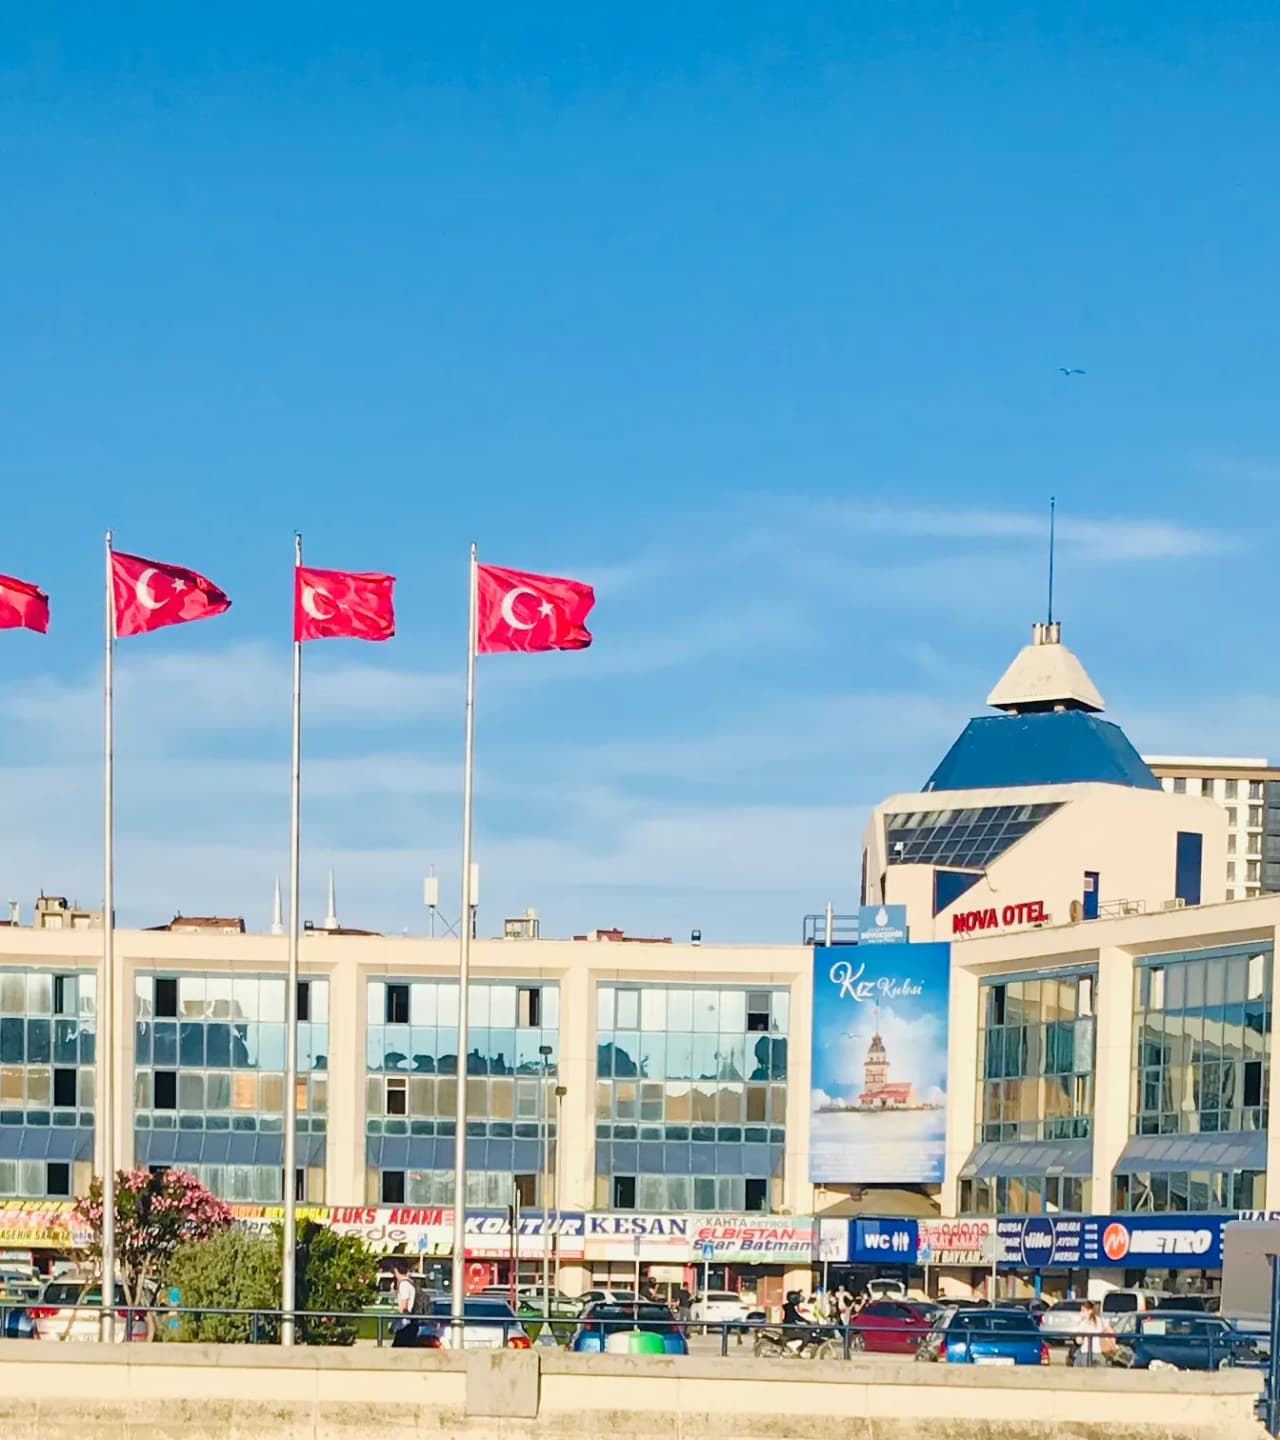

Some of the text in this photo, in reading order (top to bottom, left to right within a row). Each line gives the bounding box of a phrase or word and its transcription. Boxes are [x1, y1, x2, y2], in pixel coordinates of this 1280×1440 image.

[952, 900, 1050, 934] NOVA OTEL
[388, 1207, 443, 1226] ADANA
[864, 1233, 891, 1250] WC
[1129, 1229, 1213, 1255] METRO
